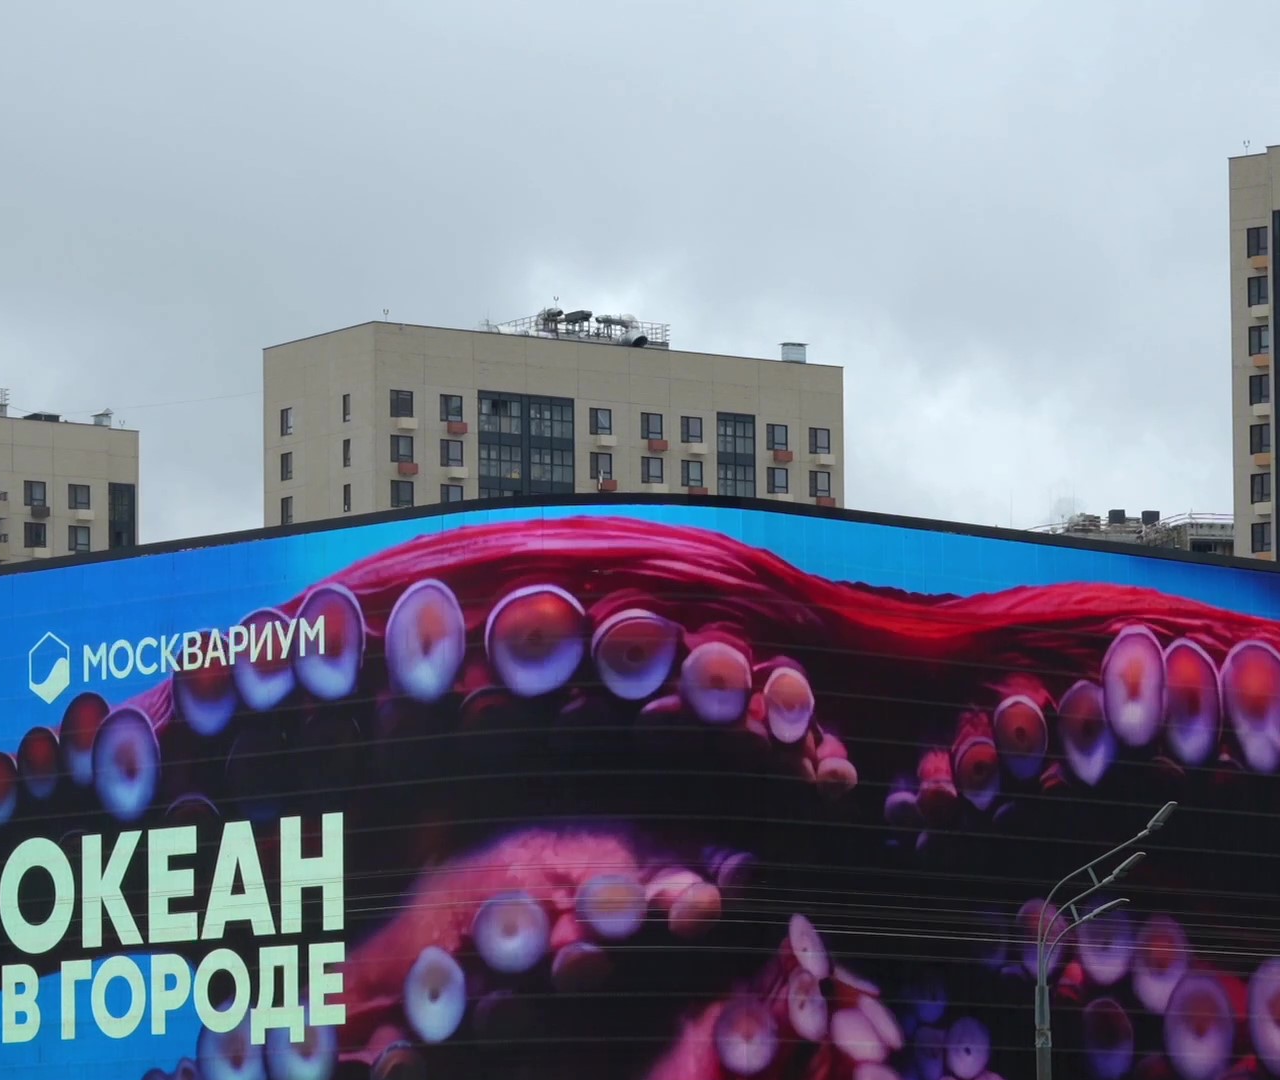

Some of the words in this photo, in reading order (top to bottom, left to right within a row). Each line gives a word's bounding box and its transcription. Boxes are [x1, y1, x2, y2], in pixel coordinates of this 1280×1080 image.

[83, 615, 325, 682] МОСКВАРИУМ
[0, 812, 344, 954] ОКЕАН
[2, 964, 41, 1043] В
[61, 942, 346, 1045] ГОРОДЕ
